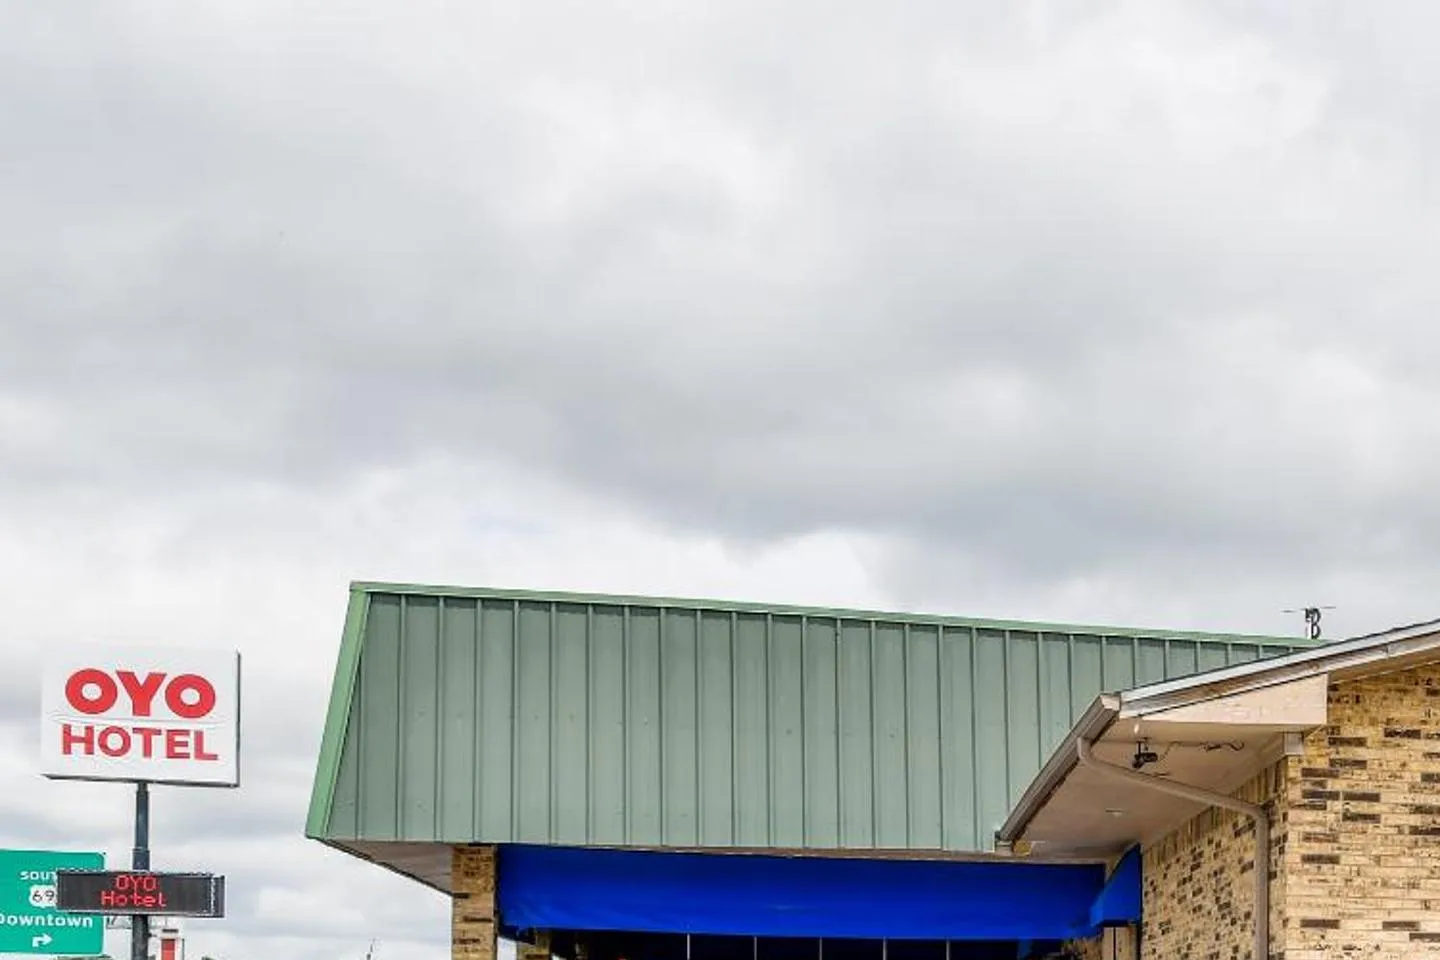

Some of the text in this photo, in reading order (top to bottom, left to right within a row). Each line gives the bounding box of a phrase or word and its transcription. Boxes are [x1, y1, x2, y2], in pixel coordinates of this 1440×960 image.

[65, 667, 216, 719] OYO
[61, 724, 219, 761] HOTEL
[20, 871, 57, 880] SOUT
[115, 875, 157, 891] OYO
[32, 890, 55, 903] 69
[101, 891, 167, 907] Hotel
